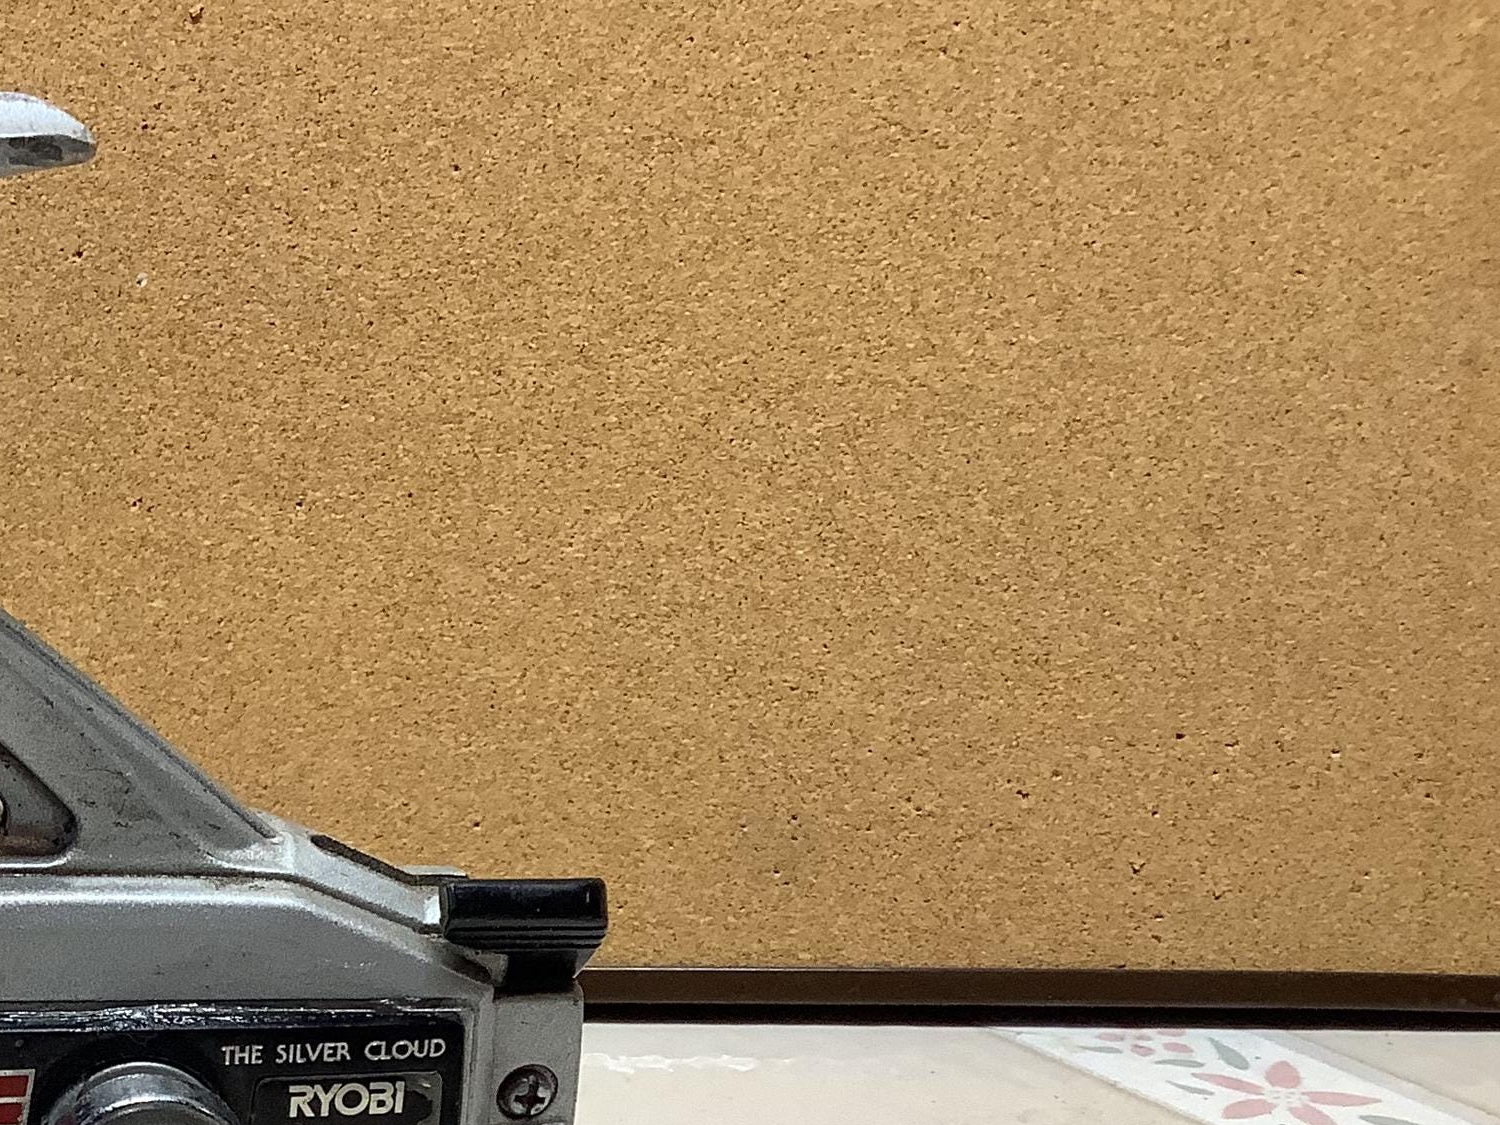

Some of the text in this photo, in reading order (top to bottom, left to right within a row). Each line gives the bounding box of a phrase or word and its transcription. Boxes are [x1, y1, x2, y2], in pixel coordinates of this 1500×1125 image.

[221, 1038, 446, 1065] THE SILVER CLOUD
[288, 1081, 405, 1118] RYOBI
